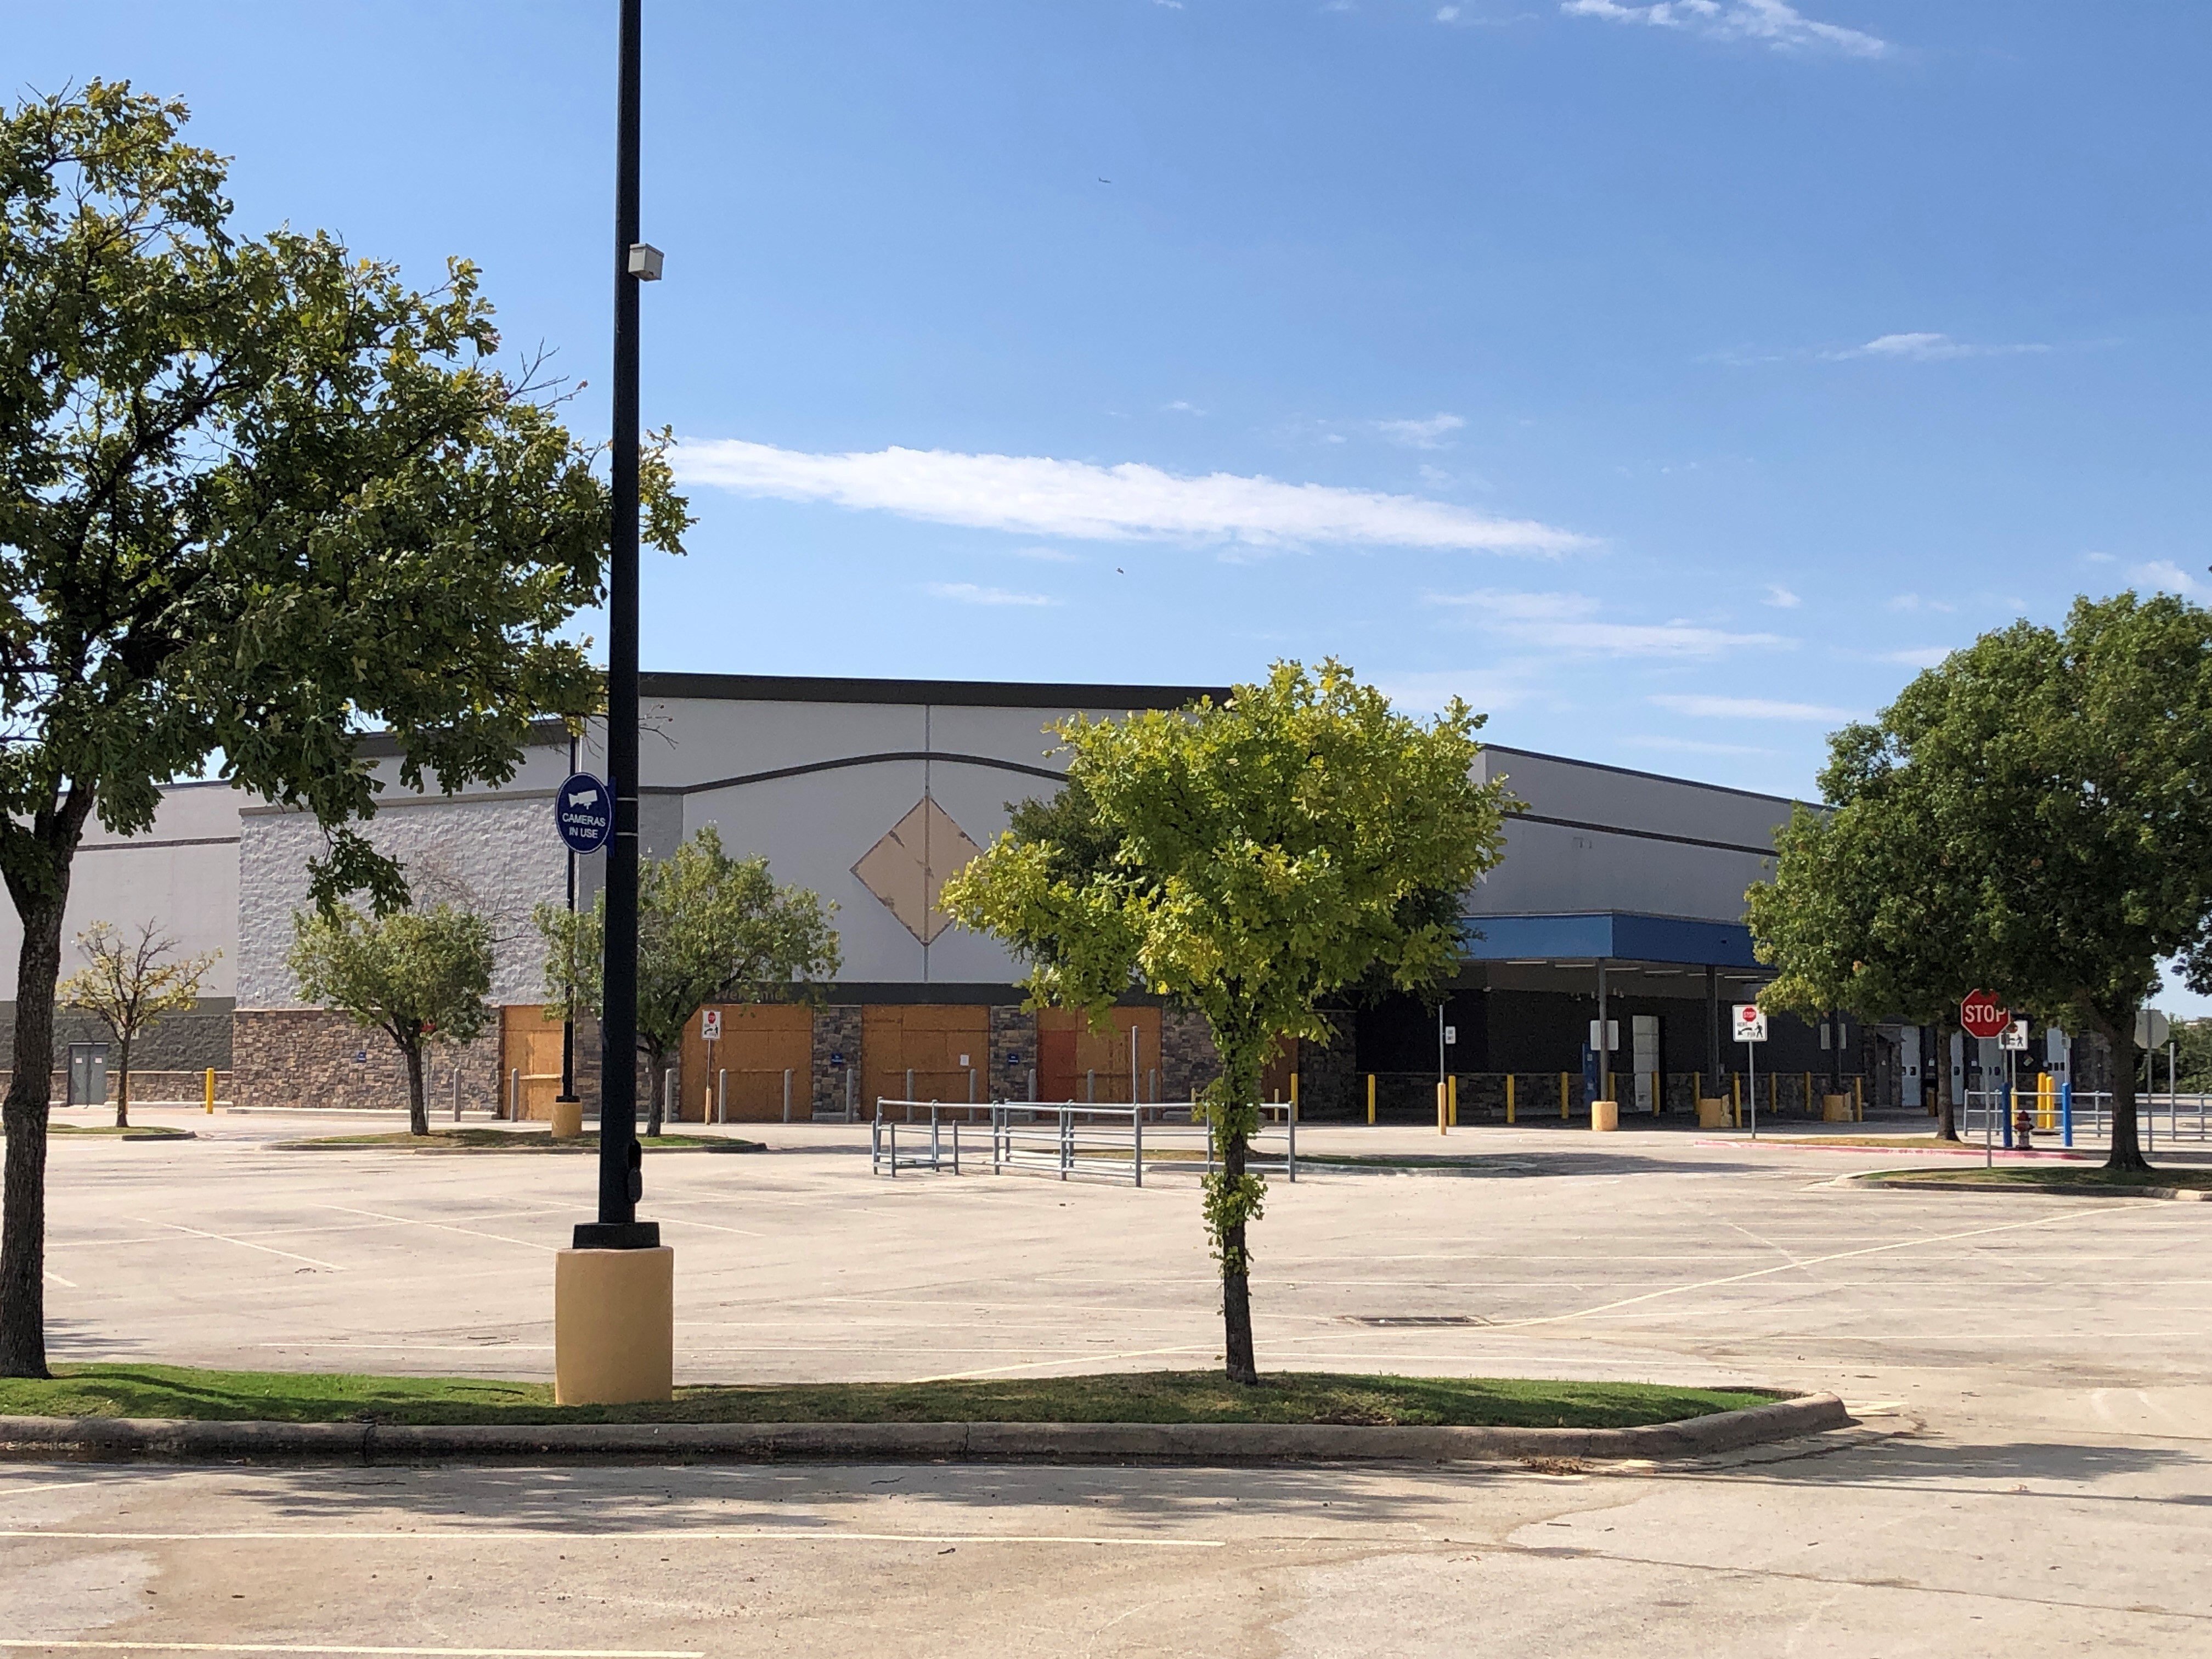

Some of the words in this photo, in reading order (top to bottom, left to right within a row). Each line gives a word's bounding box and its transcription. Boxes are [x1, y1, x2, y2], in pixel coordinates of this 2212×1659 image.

[562, 812, 606, 827] CAMERAS
[569, 827, 578, 837] IN
[580, 828, 599, 839] USE
[1965, 1005, 2007, 1023] STOP
